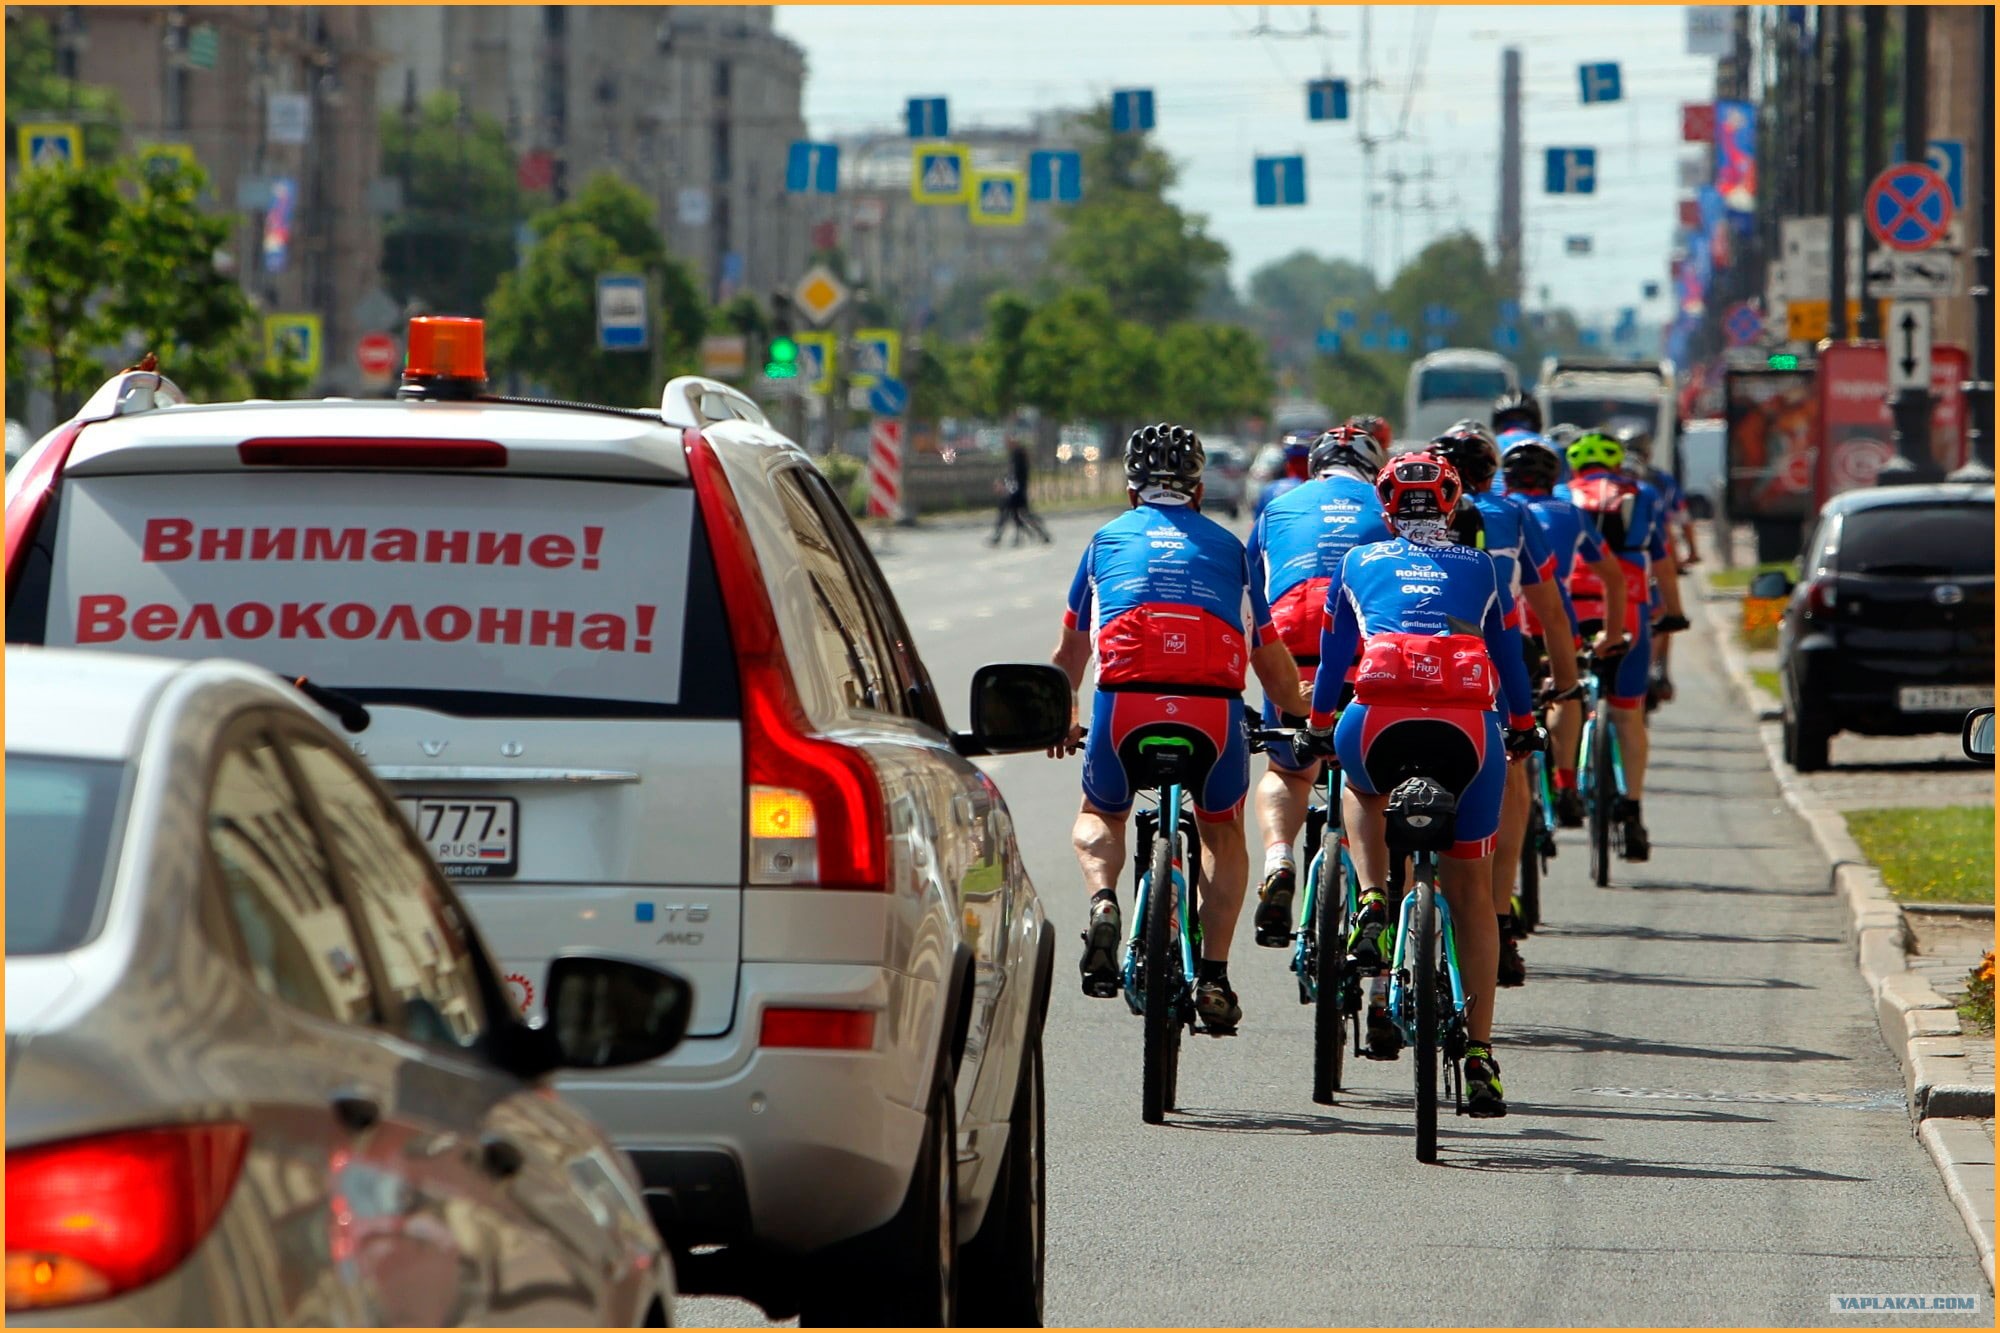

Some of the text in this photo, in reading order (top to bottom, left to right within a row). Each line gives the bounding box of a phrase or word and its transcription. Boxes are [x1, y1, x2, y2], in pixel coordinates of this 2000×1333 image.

[141, 518, 605, 571] Внимание!
[76, 594, 658, 653] Велоколонна!
[1401, 620, 1442, 629] Continental
[422, 805, 497, 841] 777
[439, 844, 477, 858] RUS
[464, 865, 489, 875] CITY
